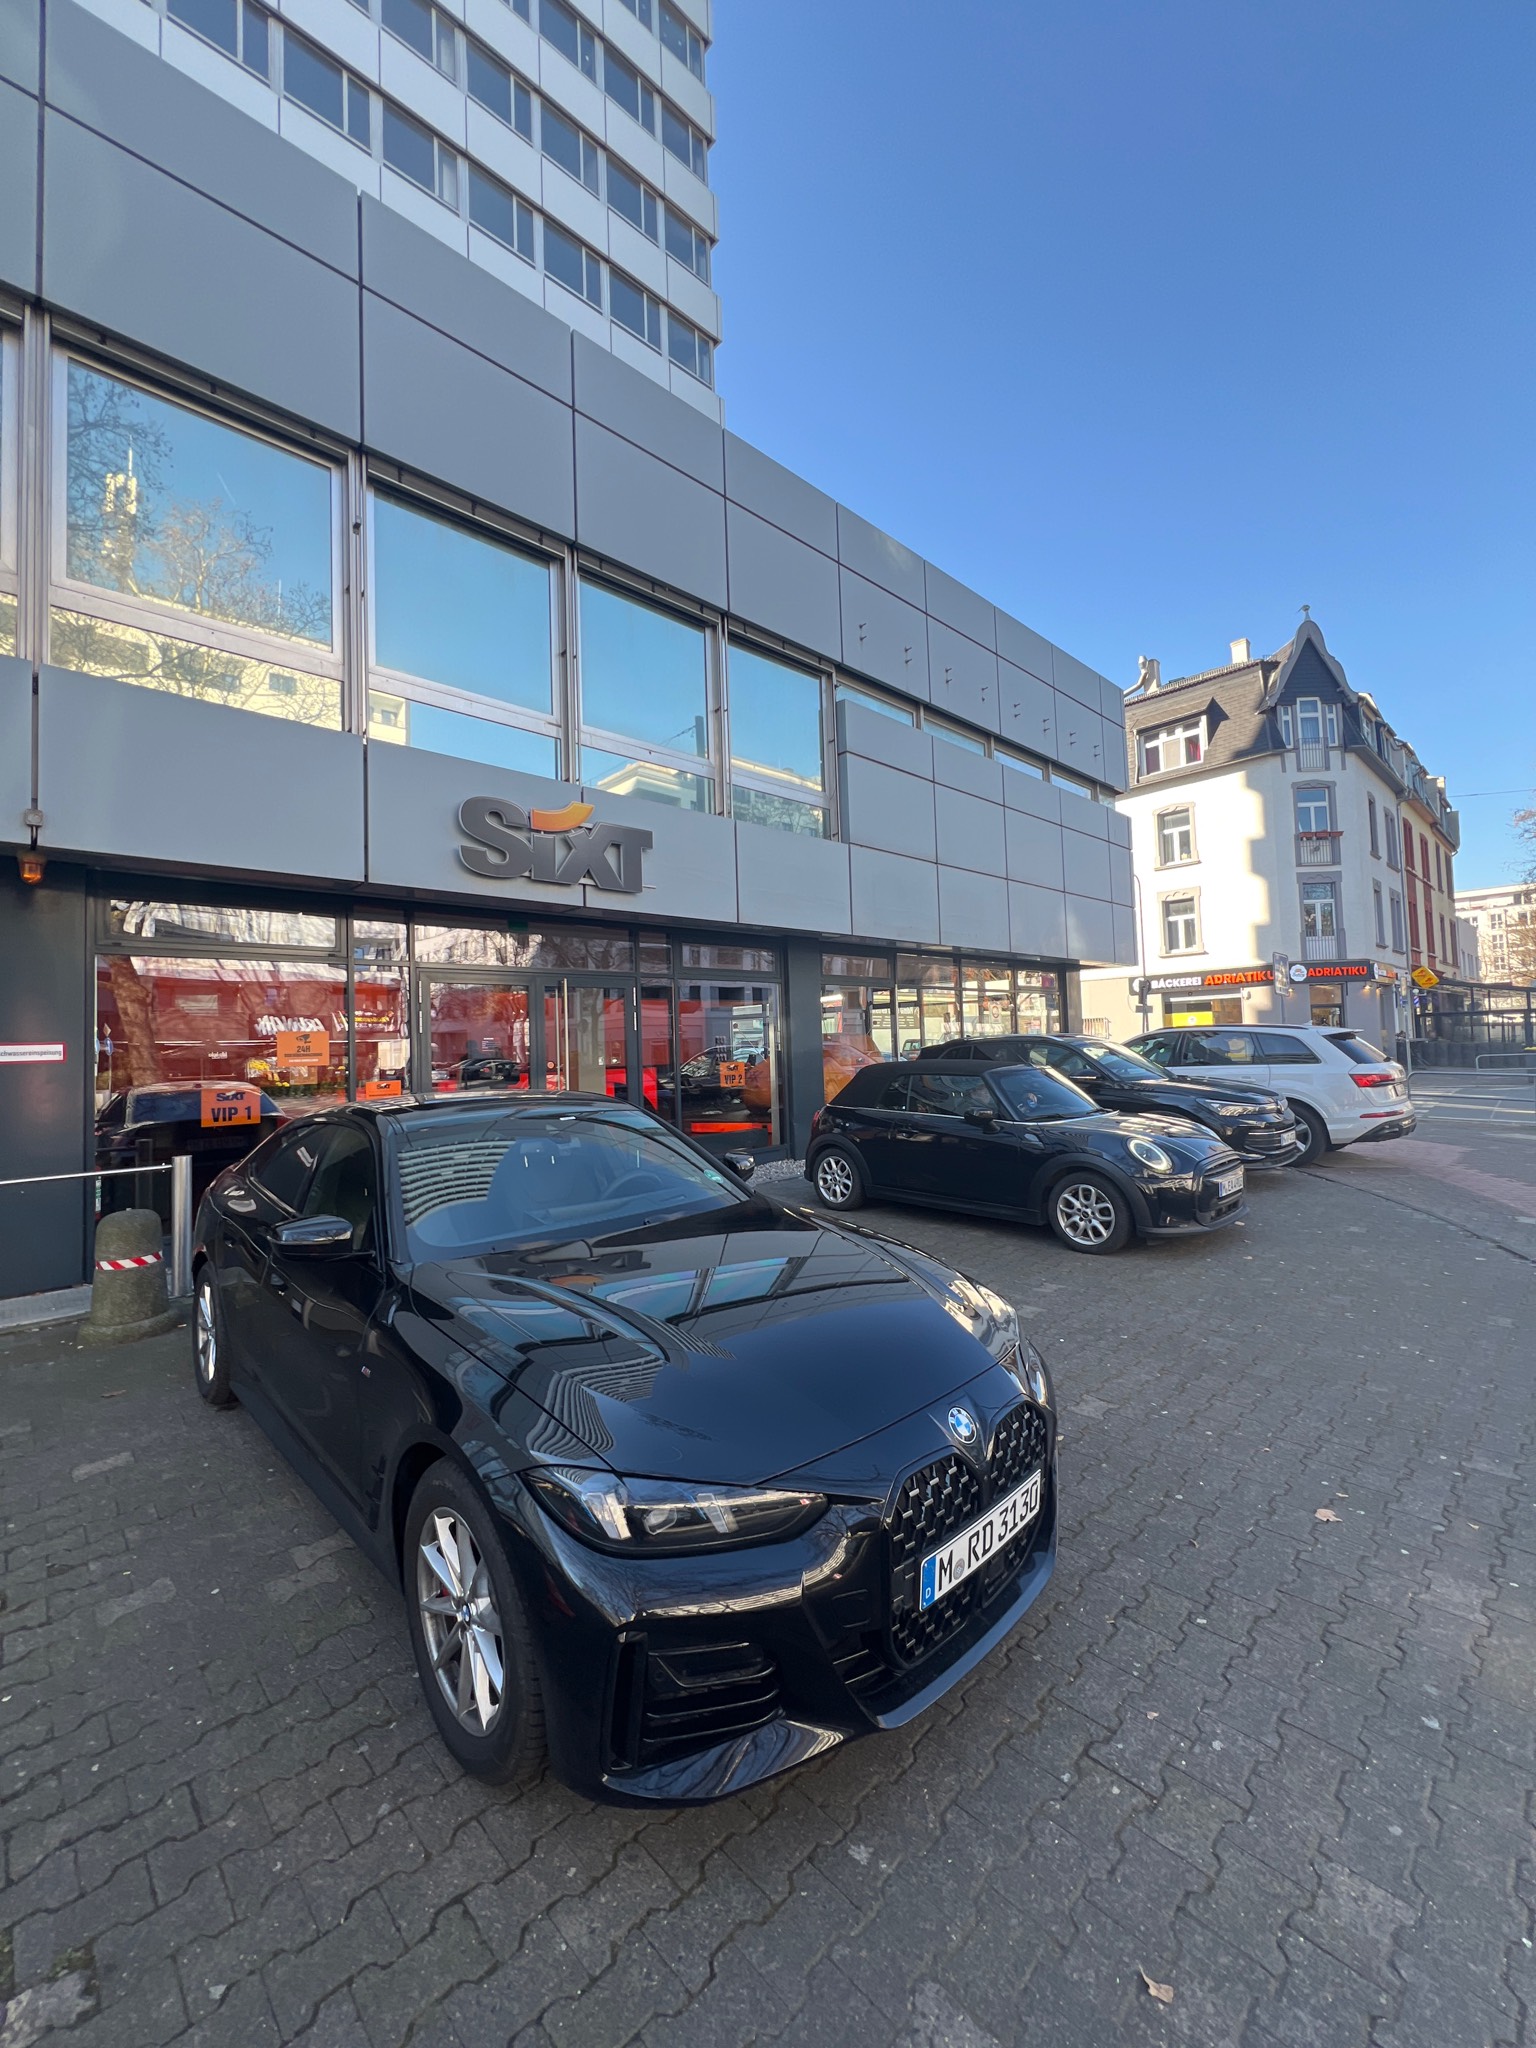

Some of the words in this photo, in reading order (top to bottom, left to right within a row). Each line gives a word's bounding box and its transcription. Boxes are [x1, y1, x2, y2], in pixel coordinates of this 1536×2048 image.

[1307, 965, 1368, 978] ADRIATIKU
[296, 1045, 311, 1053] 24H
[724, 1074, 736, 1085] VIP
[738, 1074, 743, 1084] 2
[211, 1106, 239, 1123] VIP
[244, 1105, 252, 1121] 1
[938, 1549, 953, 1592] M
[967, 1519, 994, 1570] RD
[998, 1479, 1039, 1543] 3130
[925, 1587, 932, 1599] D
